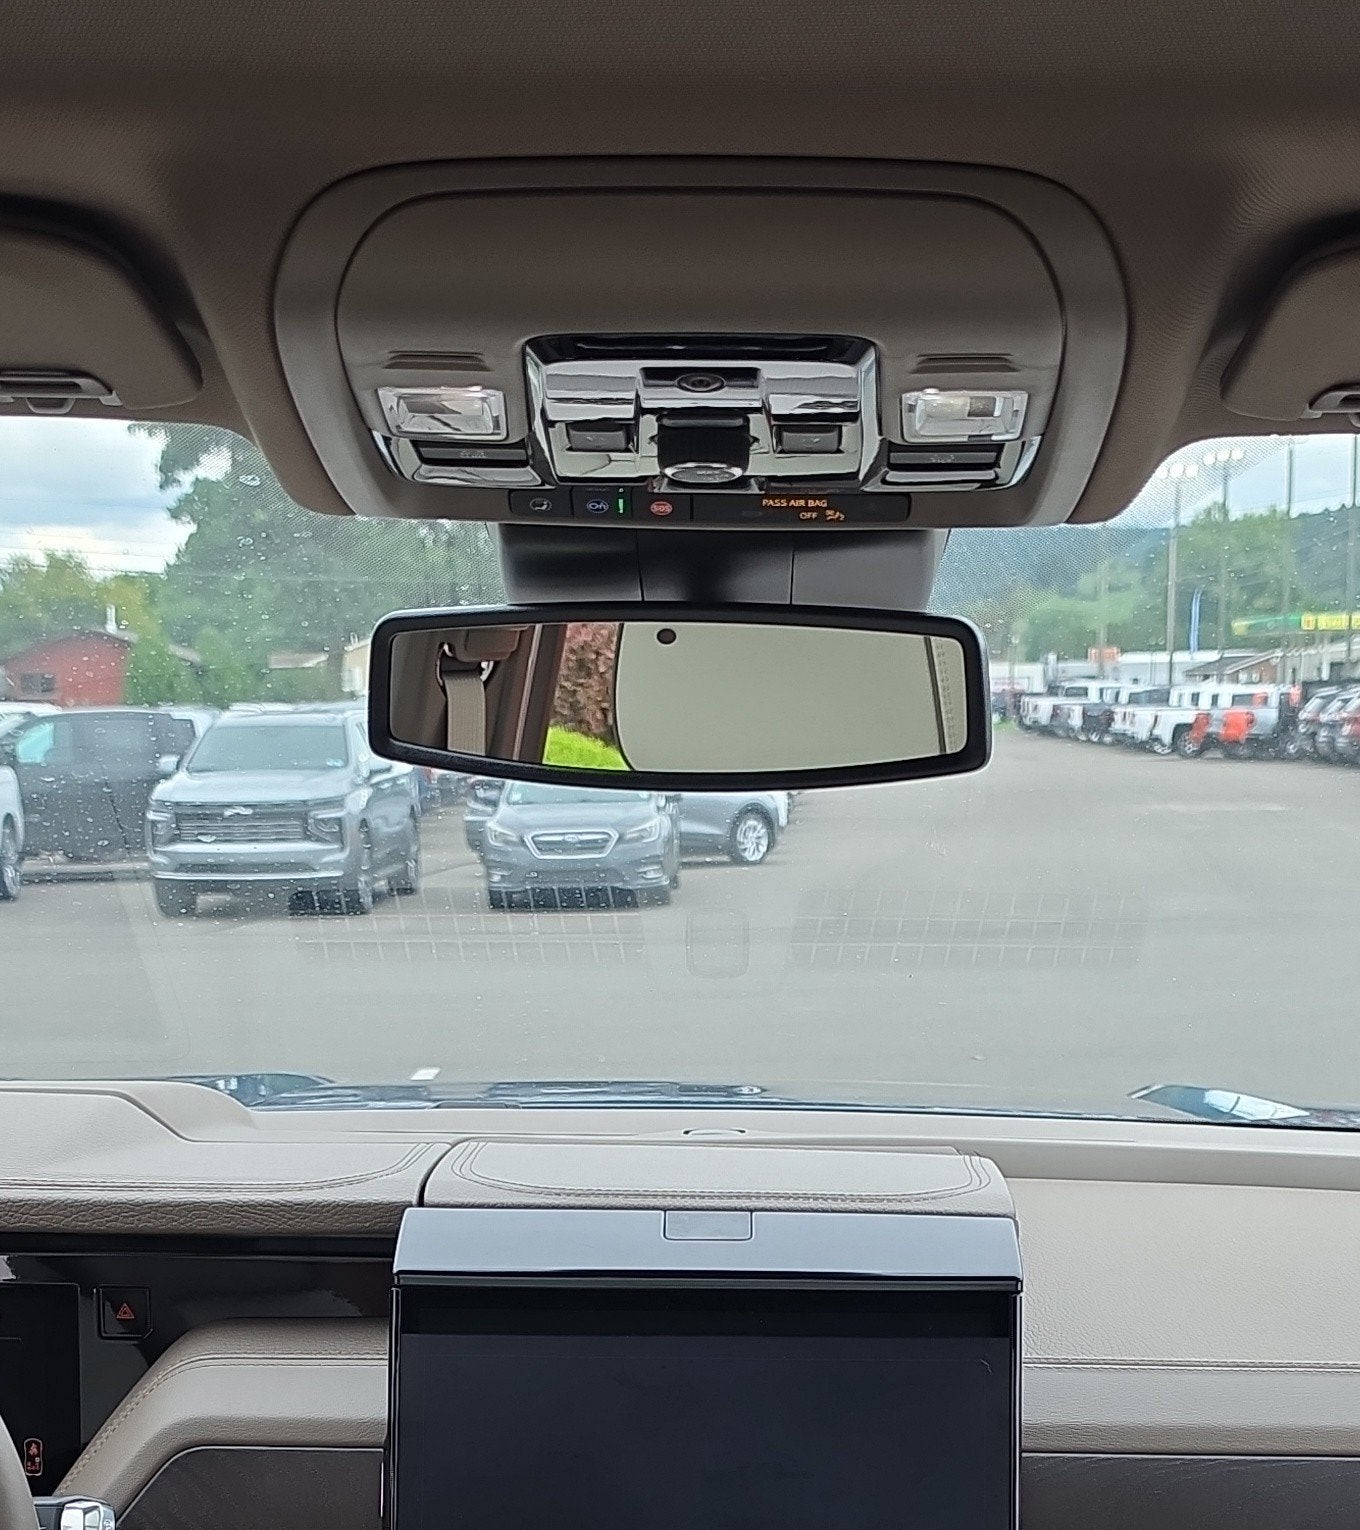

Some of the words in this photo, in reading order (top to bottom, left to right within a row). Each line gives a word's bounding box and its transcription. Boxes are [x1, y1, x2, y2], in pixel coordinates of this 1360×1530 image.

[762, 499, 787, 507] PASS
[789, 499, 805, 507] AIR
[808, 499, 828, 507] BAG
[800, 511, 818, 520] OFF
